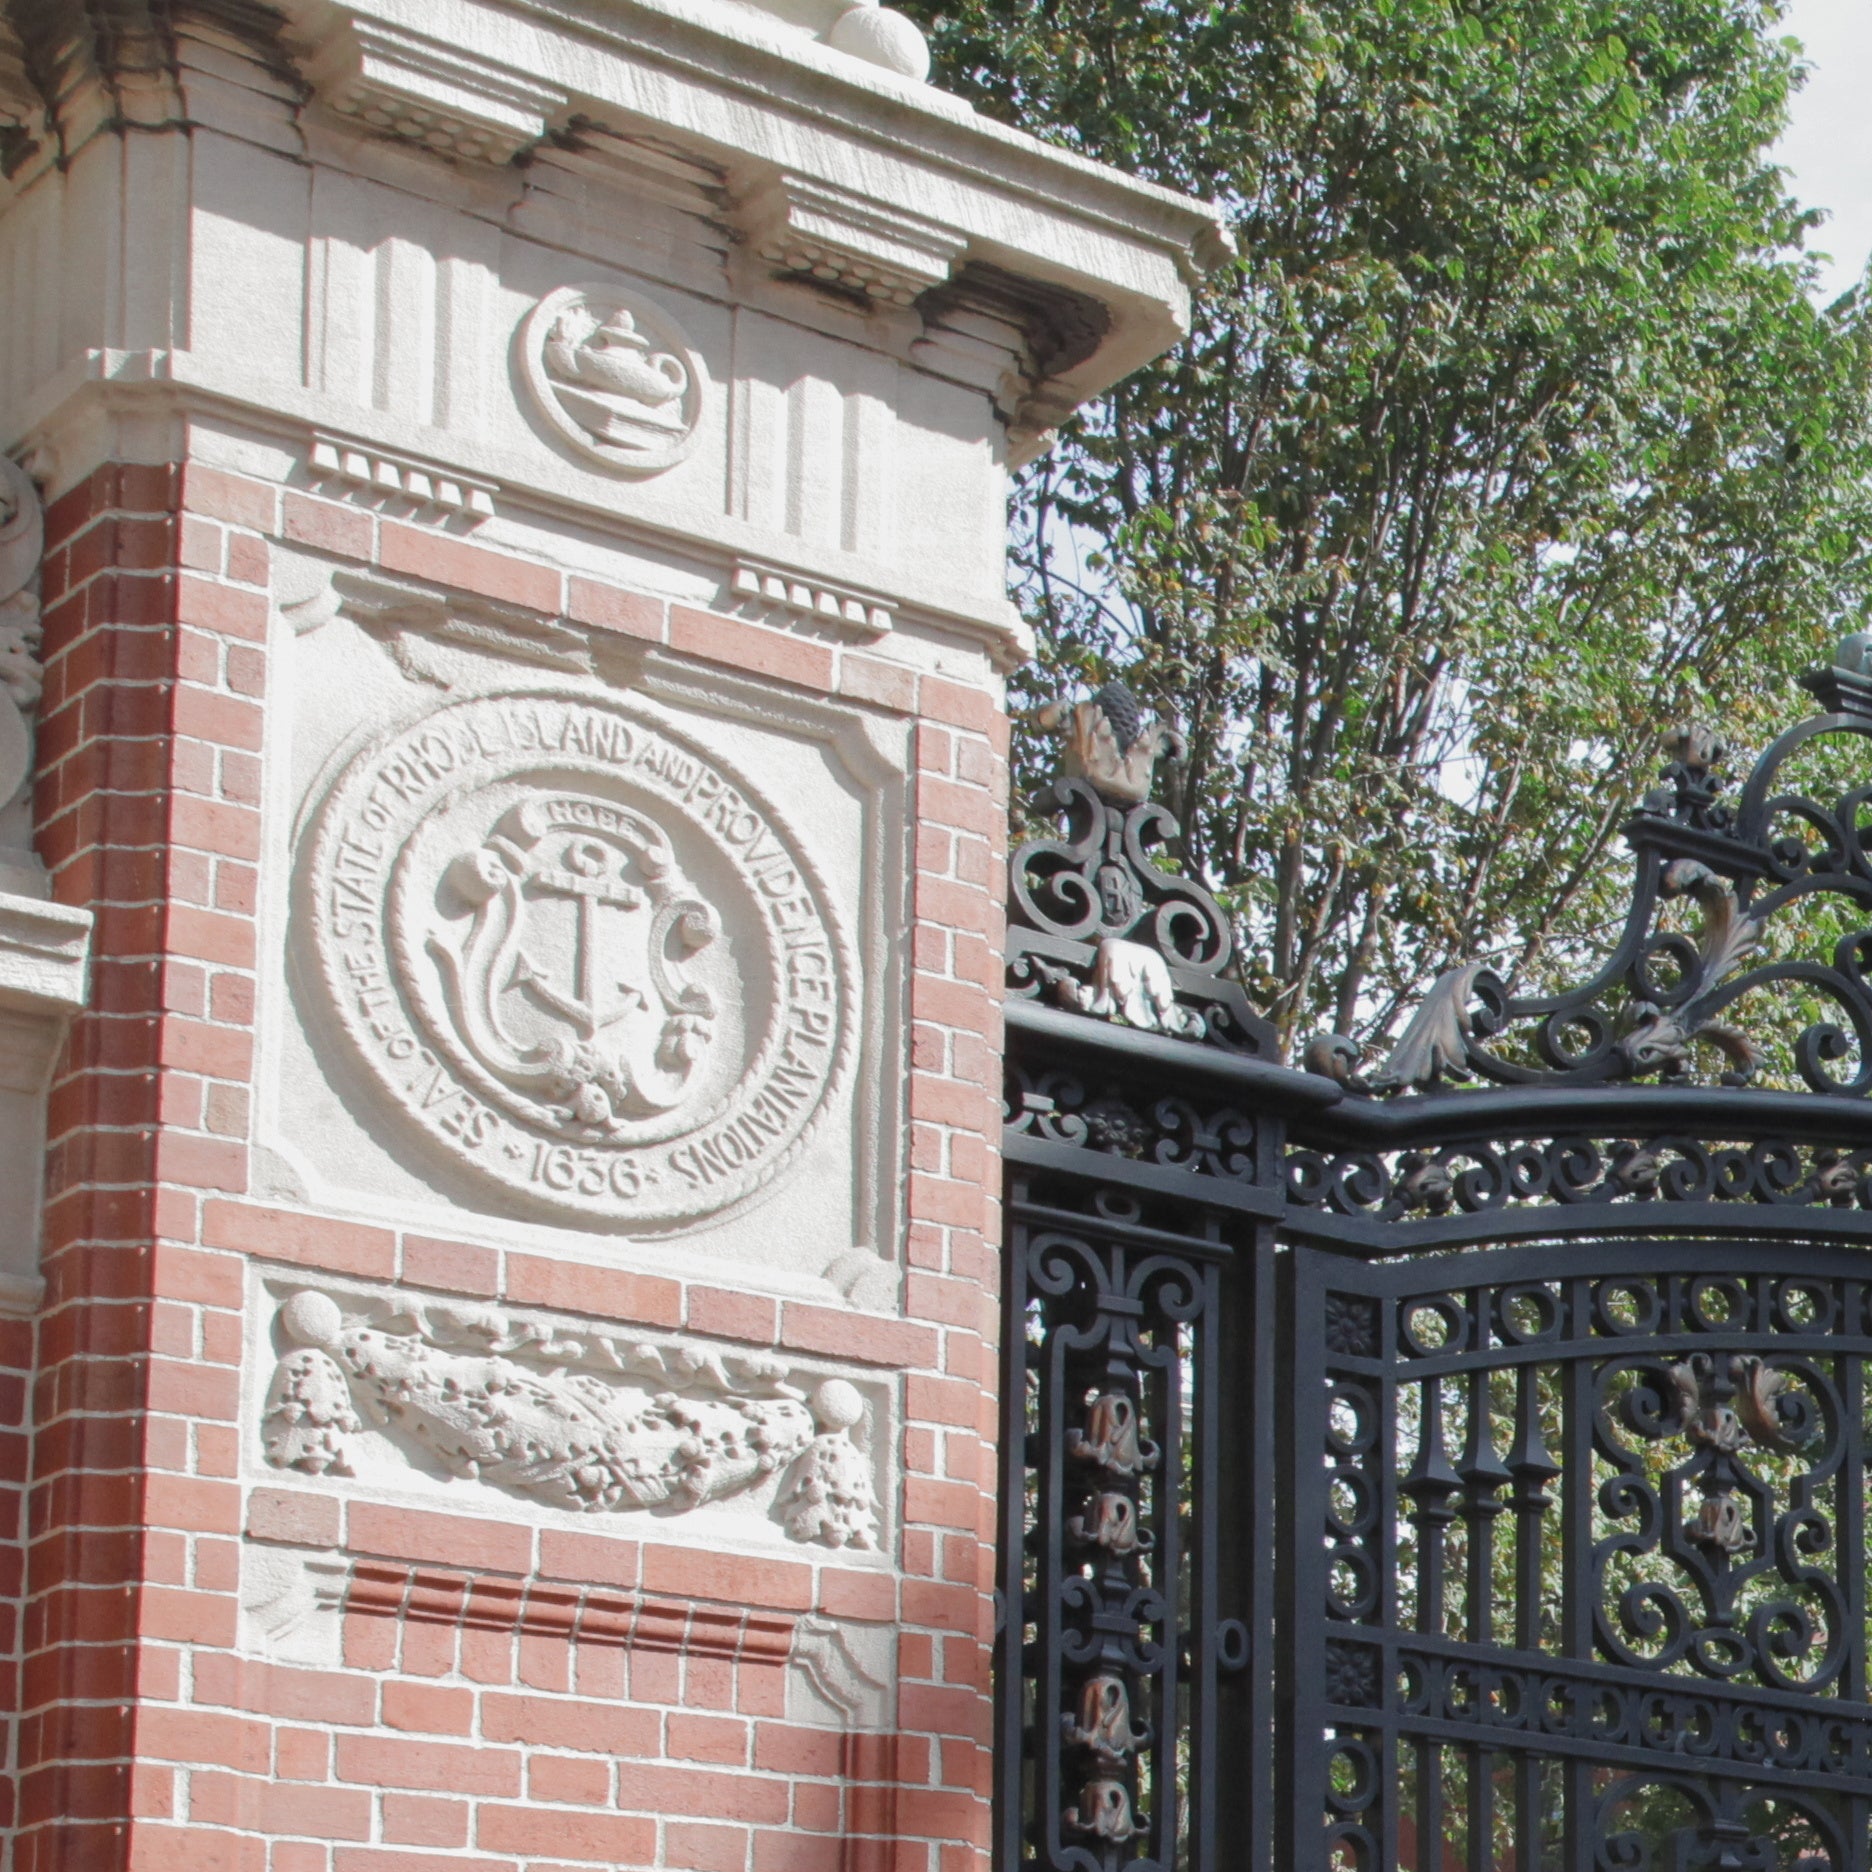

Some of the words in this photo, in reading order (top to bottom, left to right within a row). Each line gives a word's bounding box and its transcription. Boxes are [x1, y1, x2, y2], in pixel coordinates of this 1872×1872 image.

[376, 711, 500, 803] RHODE
[500, 704, 634, 764] ISLAND
[633, 741, 694, 789] AND
[359, 784, 397, 832] OF
[546, 800, 638, 839] HOPE
[330, 823, 384, 946] STATE
[683, 764, 830, 1001] PROVIDENCE
[343, 951, 390, 1018] THE
[370, 1021, 416, 1061] OF
[404, 1050, 501, 1149] SEAL
[668, 1003, 830, 1189] PLANTATIONS
[530, 1143, 641, 1199] 1636
